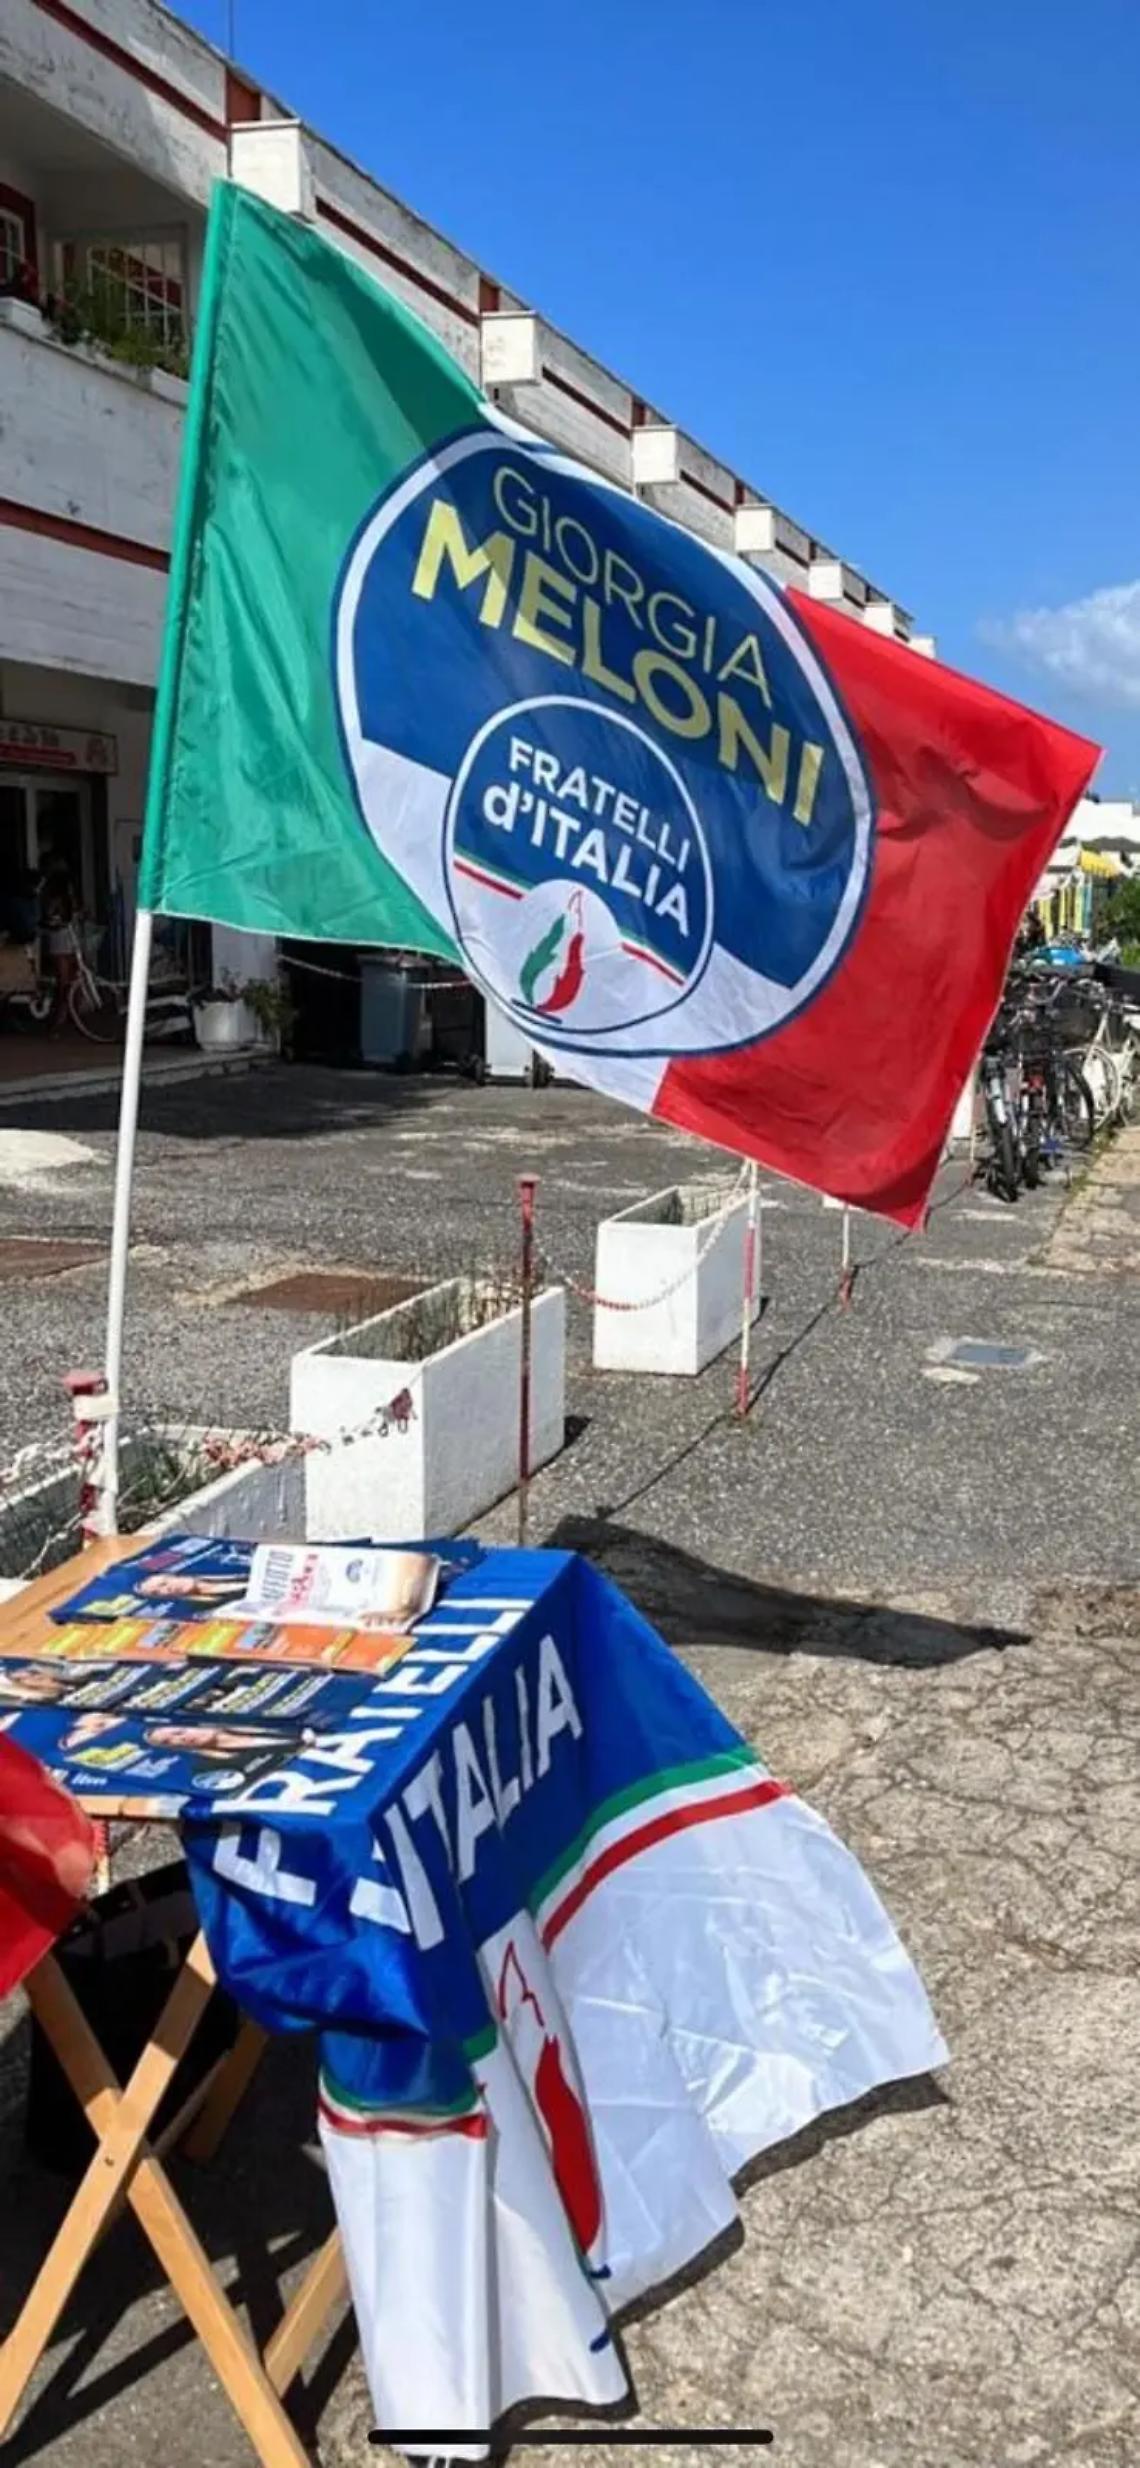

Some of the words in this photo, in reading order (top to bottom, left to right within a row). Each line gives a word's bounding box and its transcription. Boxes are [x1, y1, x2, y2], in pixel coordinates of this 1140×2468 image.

[410, 497, 824, 826] MELONI
[493, 466, 772, 708] GIORGIA
[482, 782, 690, 940] d'ITALIA
[509, 735, 691, 873] FRATELLI
